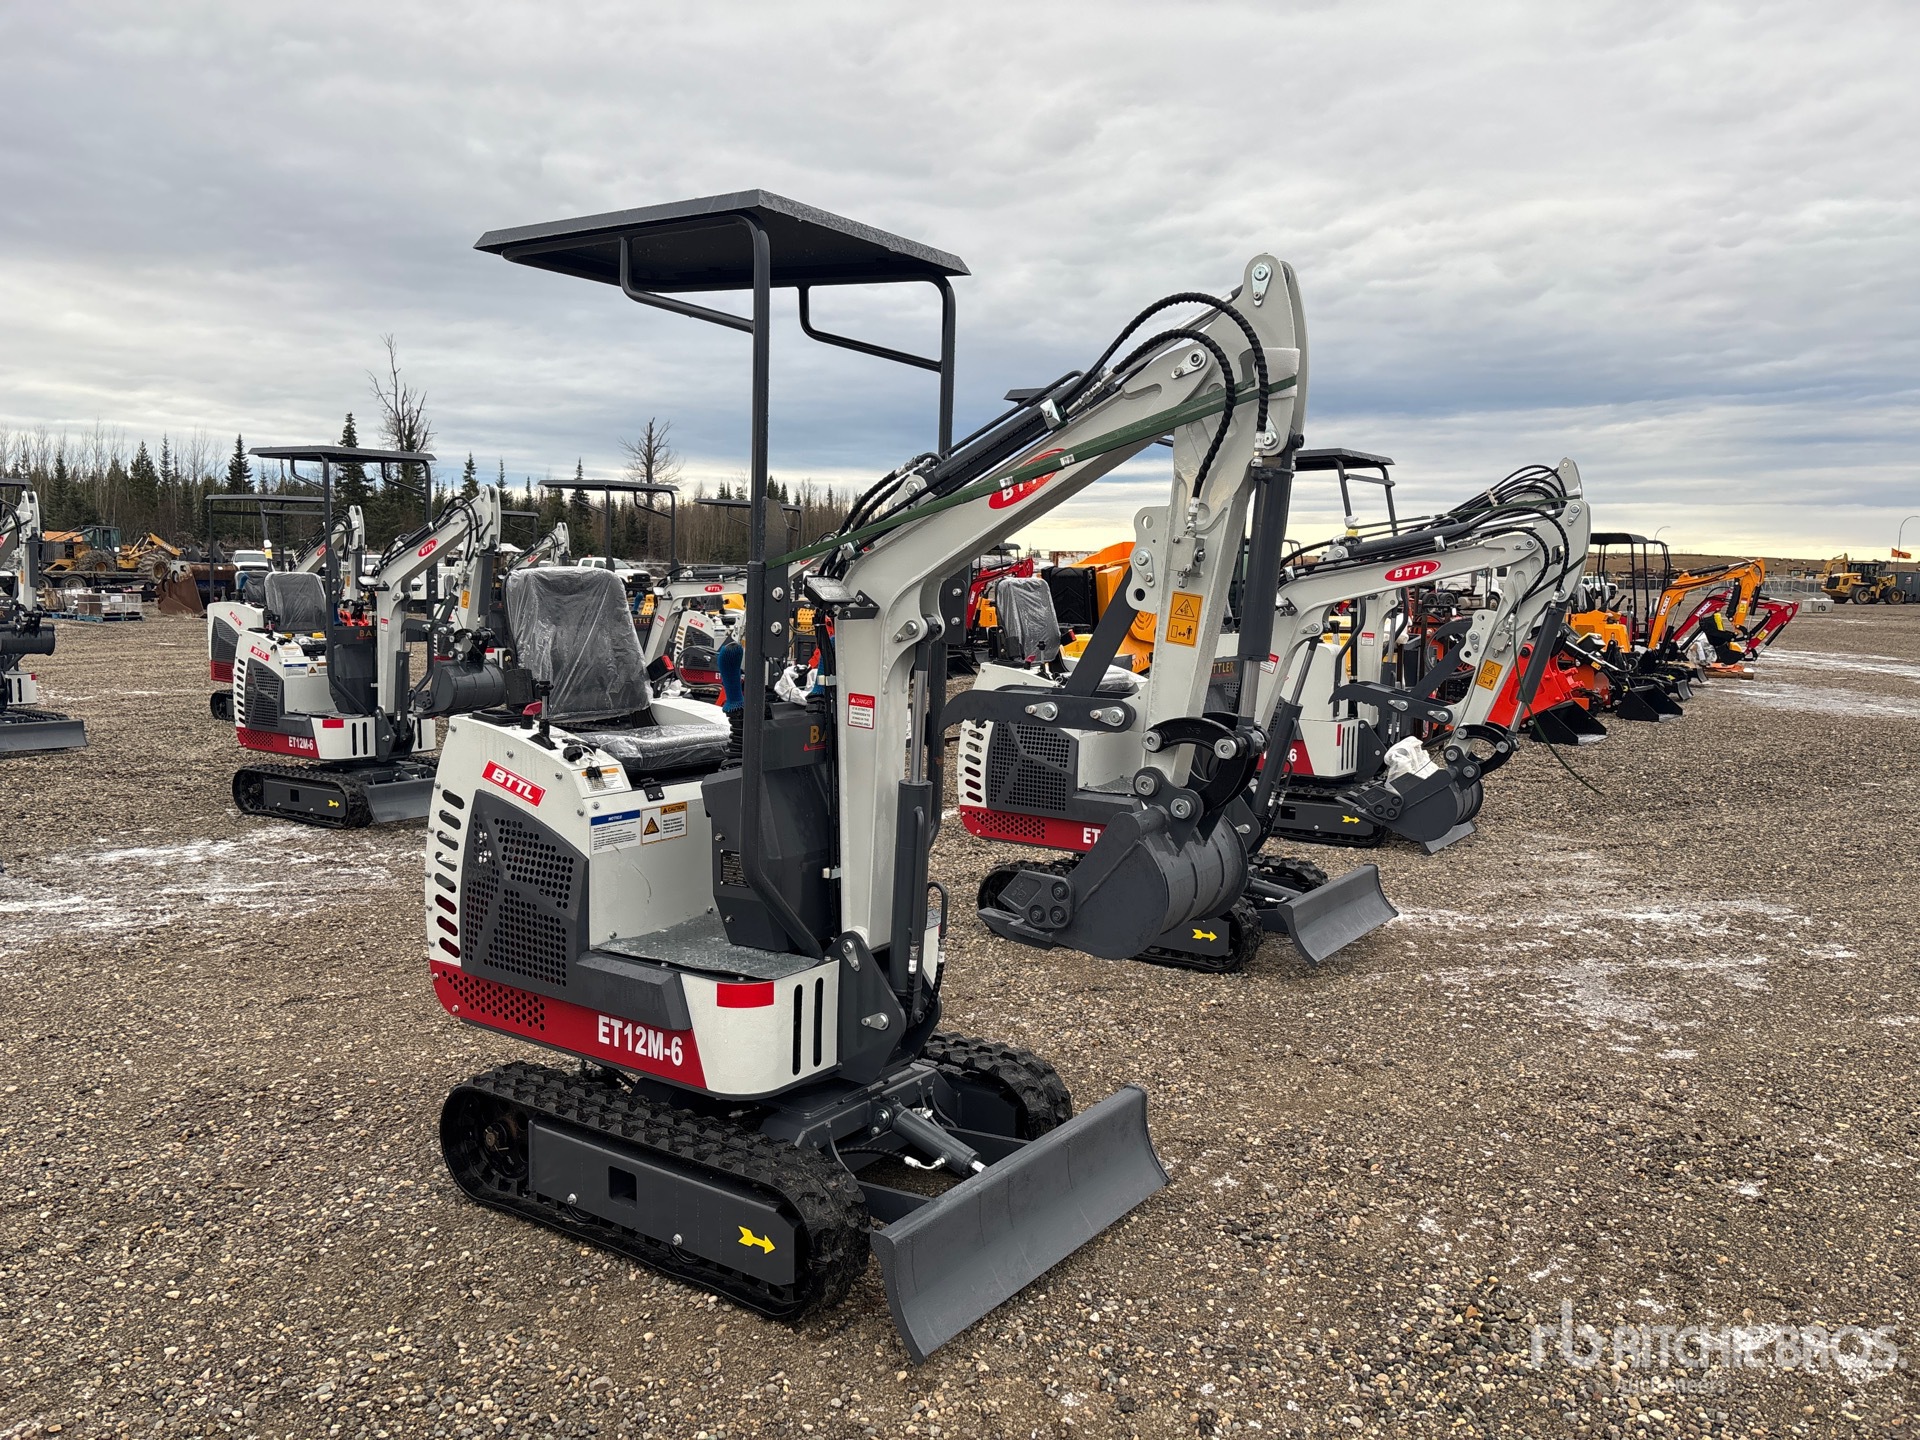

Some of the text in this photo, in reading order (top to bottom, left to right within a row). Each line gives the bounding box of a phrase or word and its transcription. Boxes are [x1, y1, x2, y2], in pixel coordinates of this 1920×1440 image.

[421, 542, 435, 555] BTTL
[1394, 565, 1429, 578] BTTL
[253, 648, 267, 659] BTTL
[856, 698, 873, 706] DANGER
[288, 736, 314, 750] ET12M-6
[491, 767, 534, 800] BTTL
[598, 1014, 683, 1067] ET12M-6
